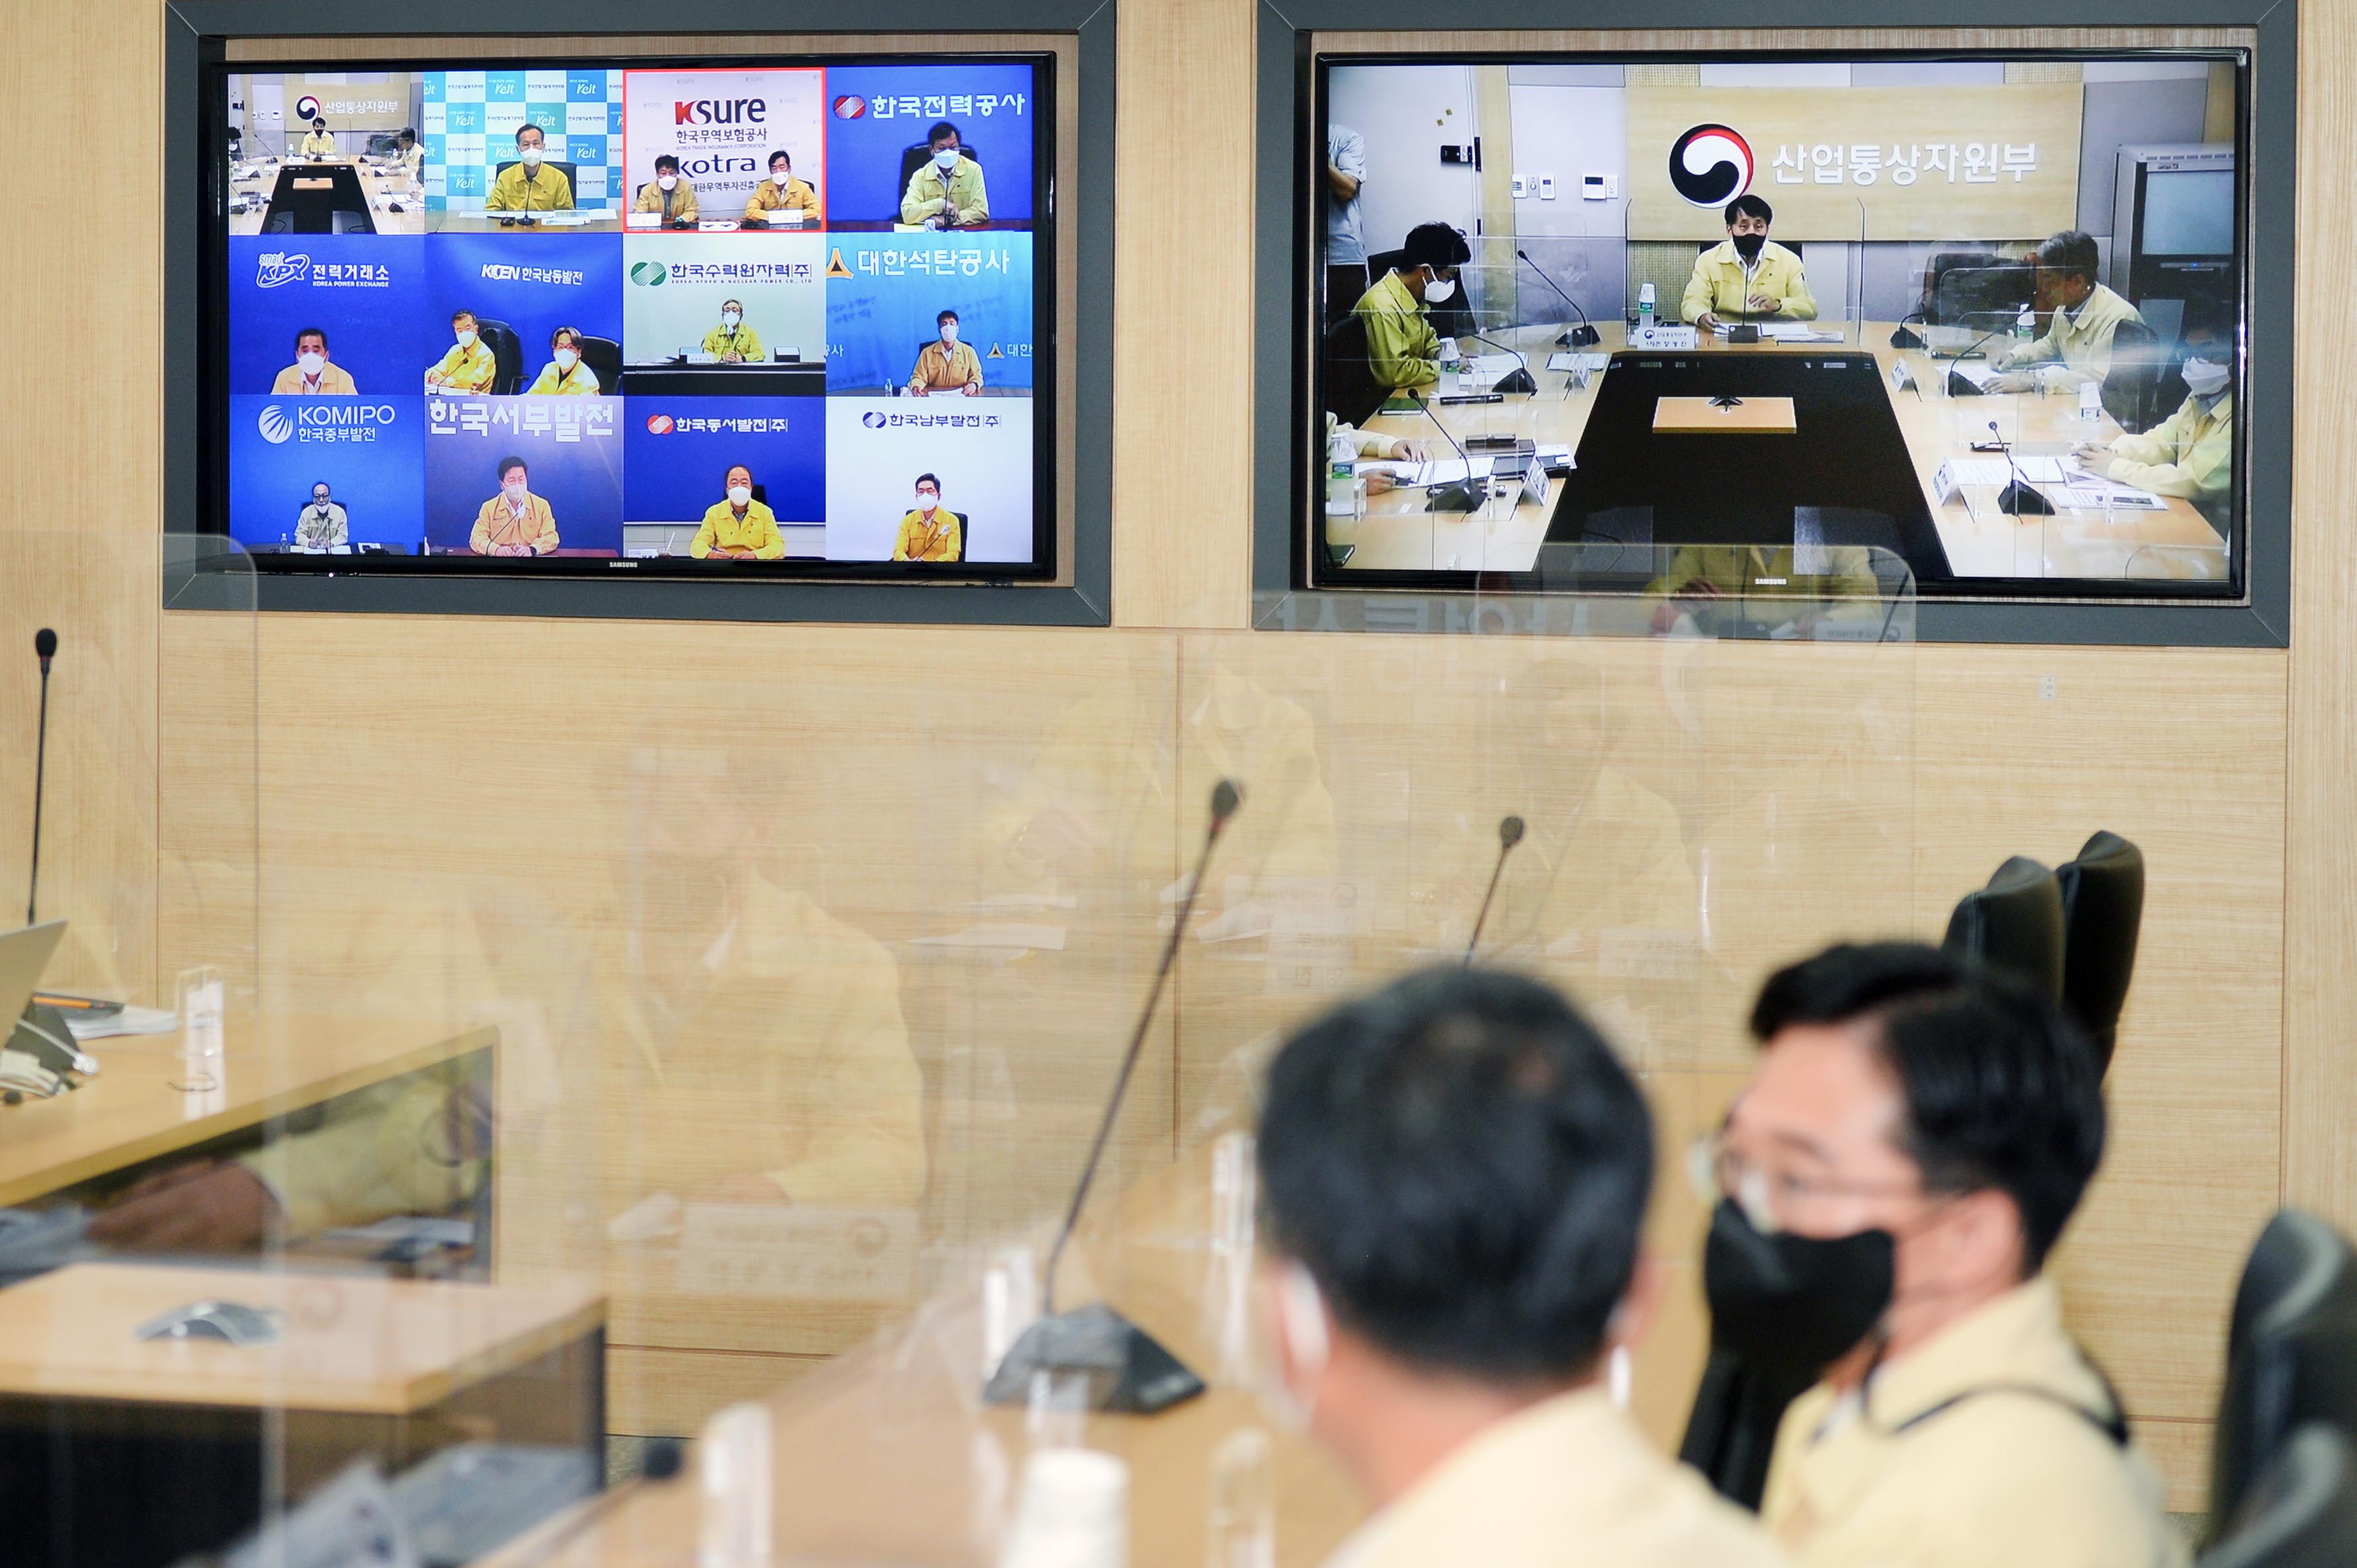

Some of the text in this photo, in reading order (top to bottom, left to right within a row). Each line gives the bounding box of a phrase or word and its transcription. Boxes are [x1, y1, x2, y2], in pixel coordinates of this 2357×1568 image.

[325, 100, 398, 115] 산업통상자원부
[871, 93, 1026, 119] 한국전력공사
[676, 128, 768, 144] 한국무역보험공사
[676, 154, 756, 178] kotra
[1771, 142, 2038, 186] 산업통상자원부
[313, 264, 389, 280] 전력거래소
[857, 248, 1010, 277] 대한석탄공사
[522, 267, 583, 285] 한국남동발전
[298, 405, 396, 425] KOMIPO
[429, 399, 613, 442] 한국서부발전
[298, 427, 376, 442] 한국중부발전
